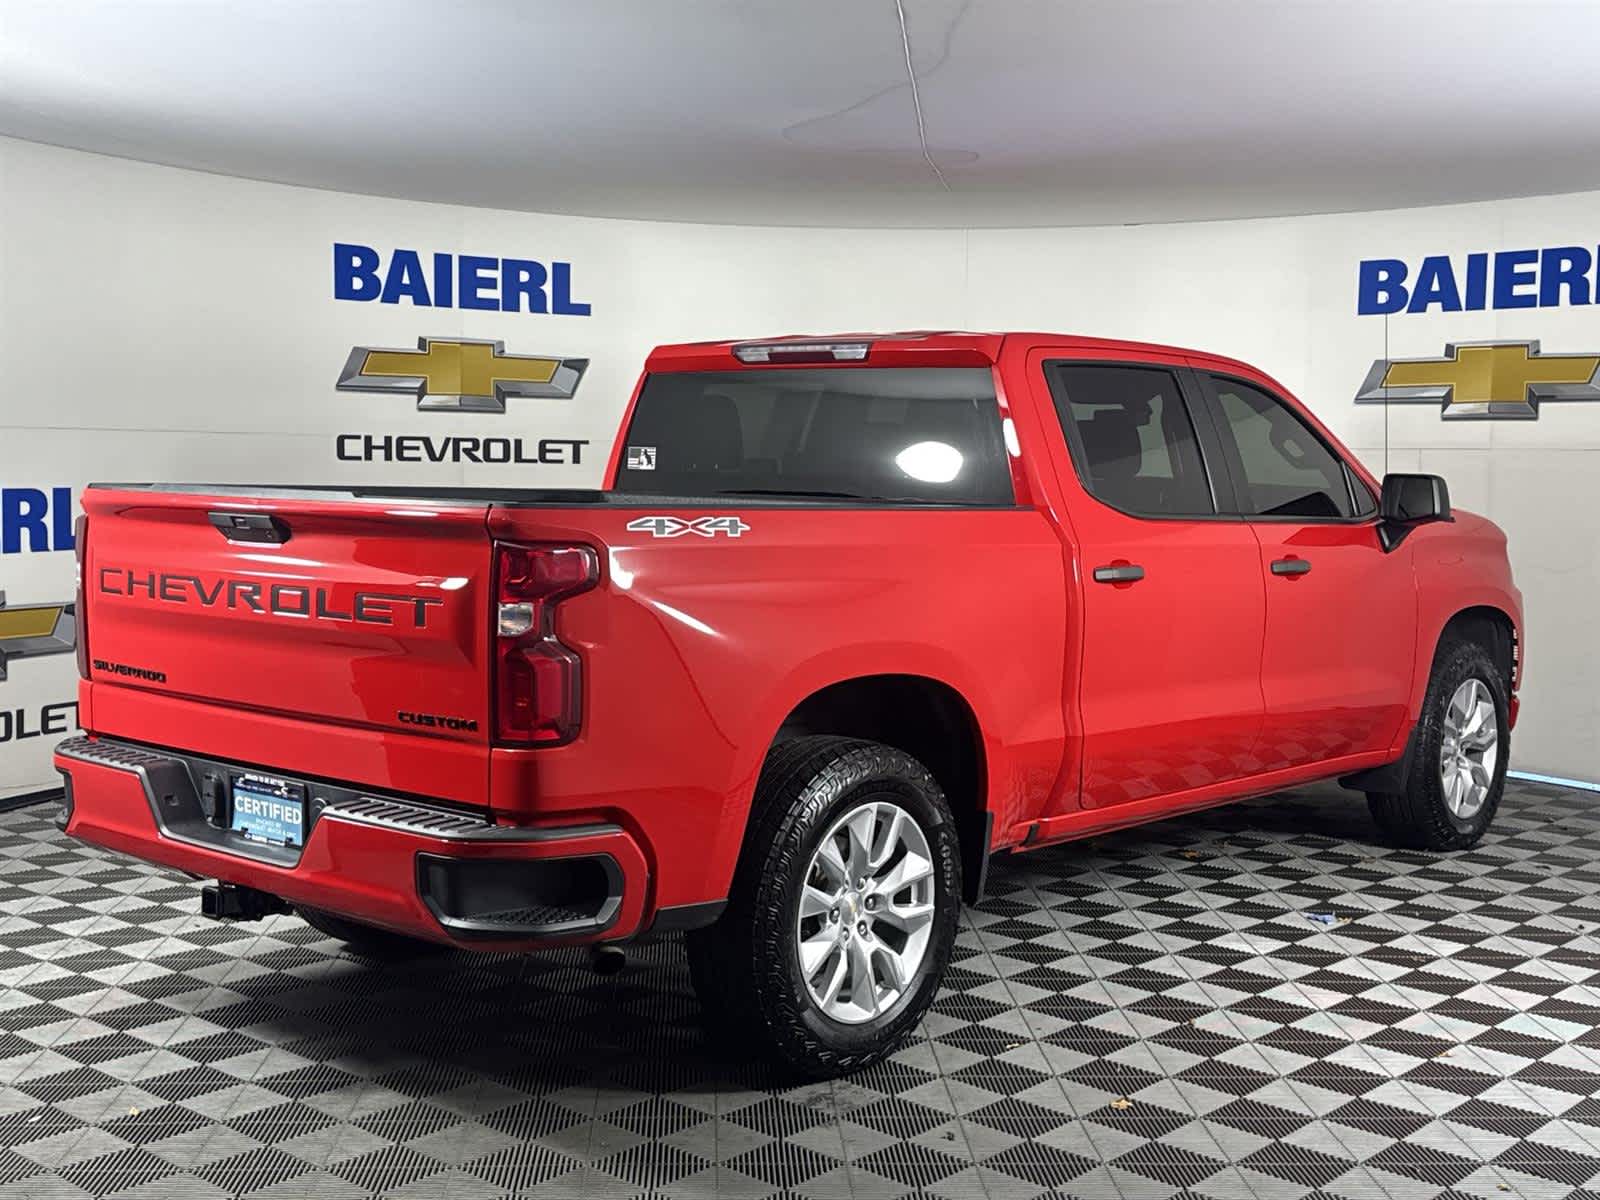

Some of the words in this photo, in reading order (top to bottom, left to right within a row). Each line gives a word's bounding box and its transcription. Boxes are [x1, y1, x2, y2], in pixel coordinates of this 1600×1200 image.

[334, 243, 591, 316] BAIERL
[1357, 245, 1600, 316] BAIER
[336, 434, 590, 464] CHEVROLET
[100, 568, 443, 628] CHEVROLET
[93, 659, 167, 684] SILVERADO
[397, 710, 478, 732] CUSTOM
[234, 795, 303, 825] CERTIFIED
